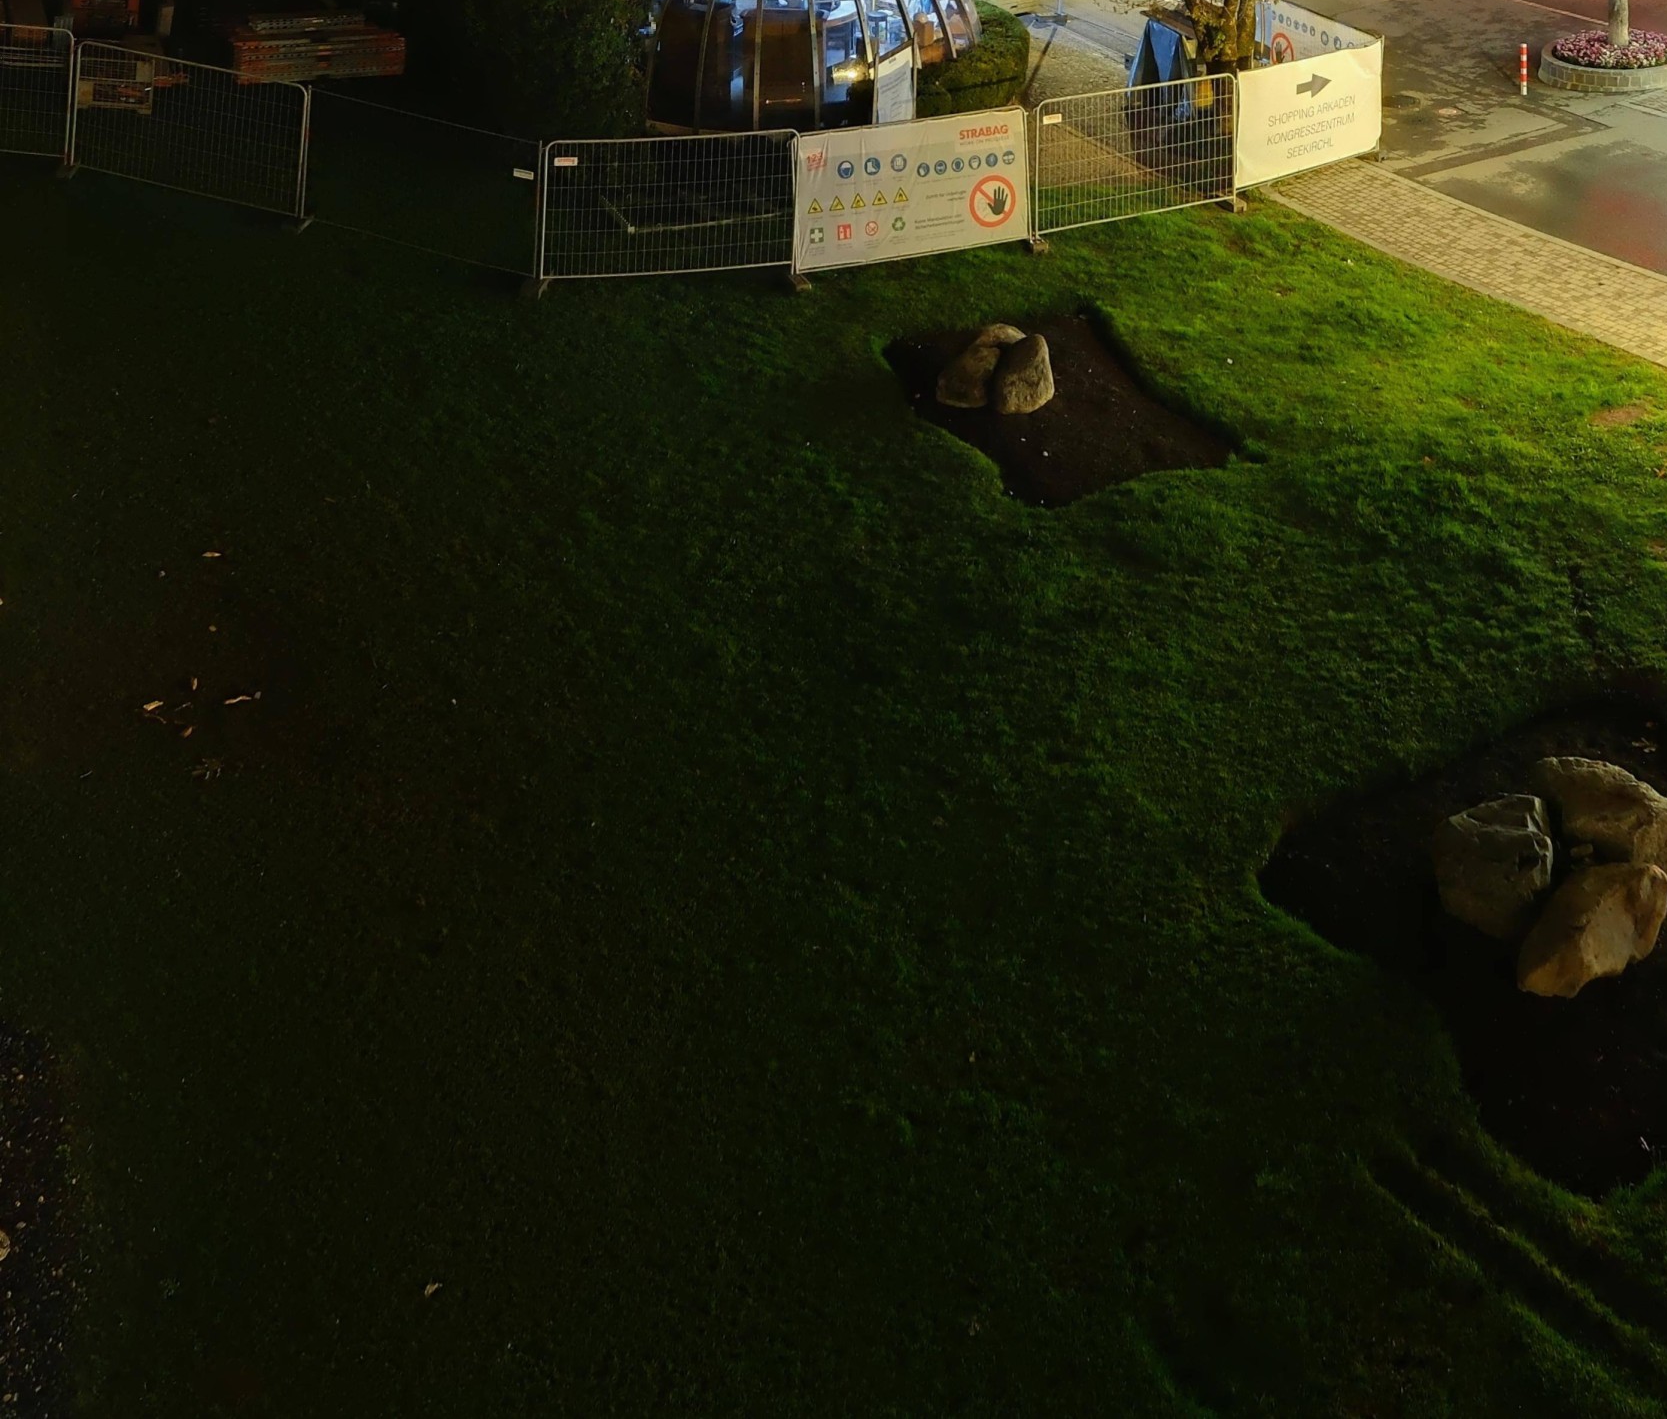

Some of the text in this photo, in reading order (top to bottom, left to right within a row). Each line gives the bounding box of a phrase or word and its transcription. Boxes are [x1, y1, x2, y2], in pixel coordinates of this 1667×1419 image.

[1268, 95, 1356, 127] SHOPPING ARKADEN
[959, 124, 1009, 140] STRABAG
[1266, 112, 1355, 146] KONGRESSZENTRUM
[1286, 137, 1334, 159] SEEKIRCHL
